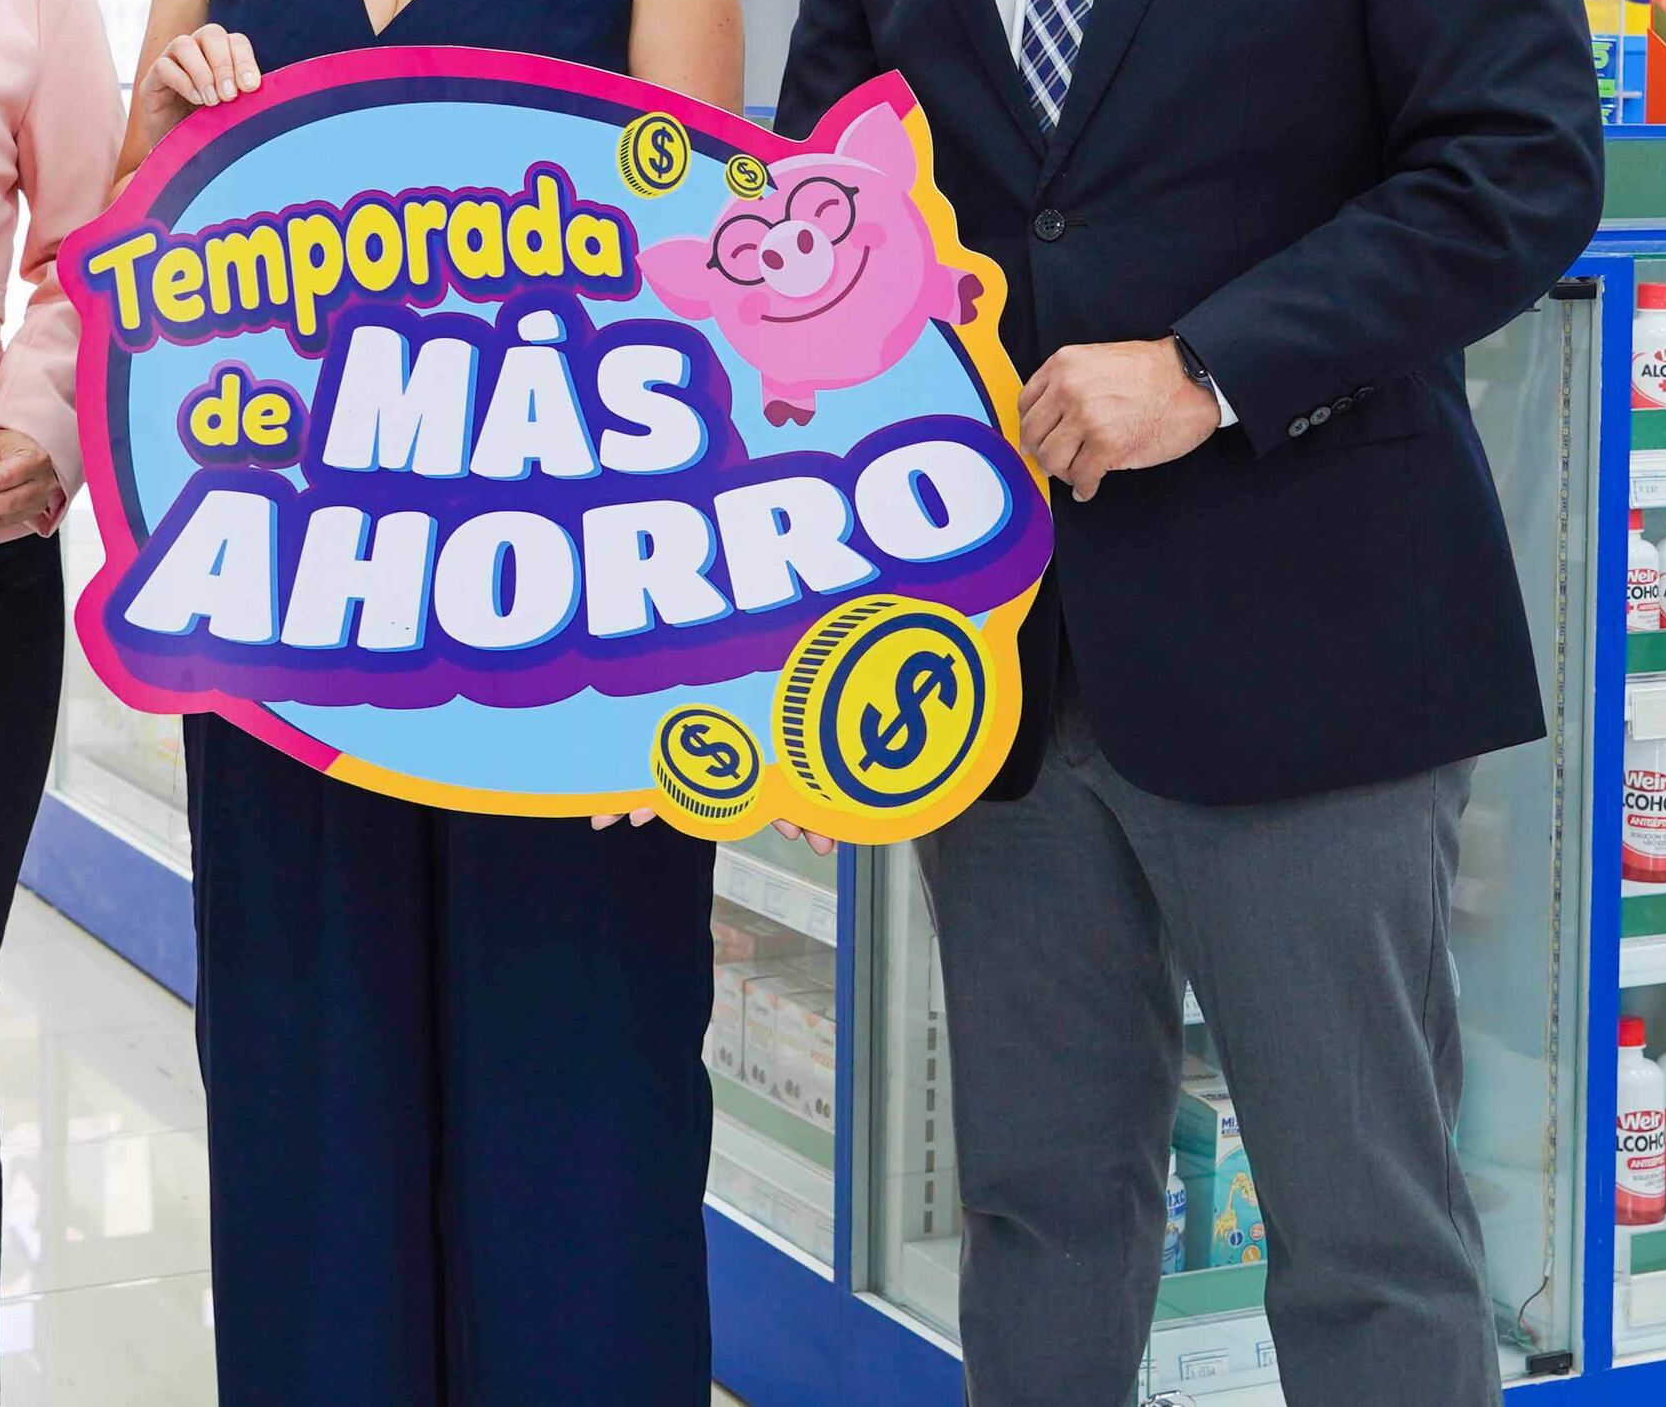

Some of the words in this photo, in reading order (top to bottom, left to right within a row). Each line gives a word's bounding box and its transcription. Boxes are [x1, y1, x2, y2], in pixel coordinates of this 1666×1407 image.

[88, 175, 624, 335] Temporada
[190, 375, 290, 448] de
[323, 310, 710, 481] MÁS
[124, 440, 1010, 651] AHORRO
